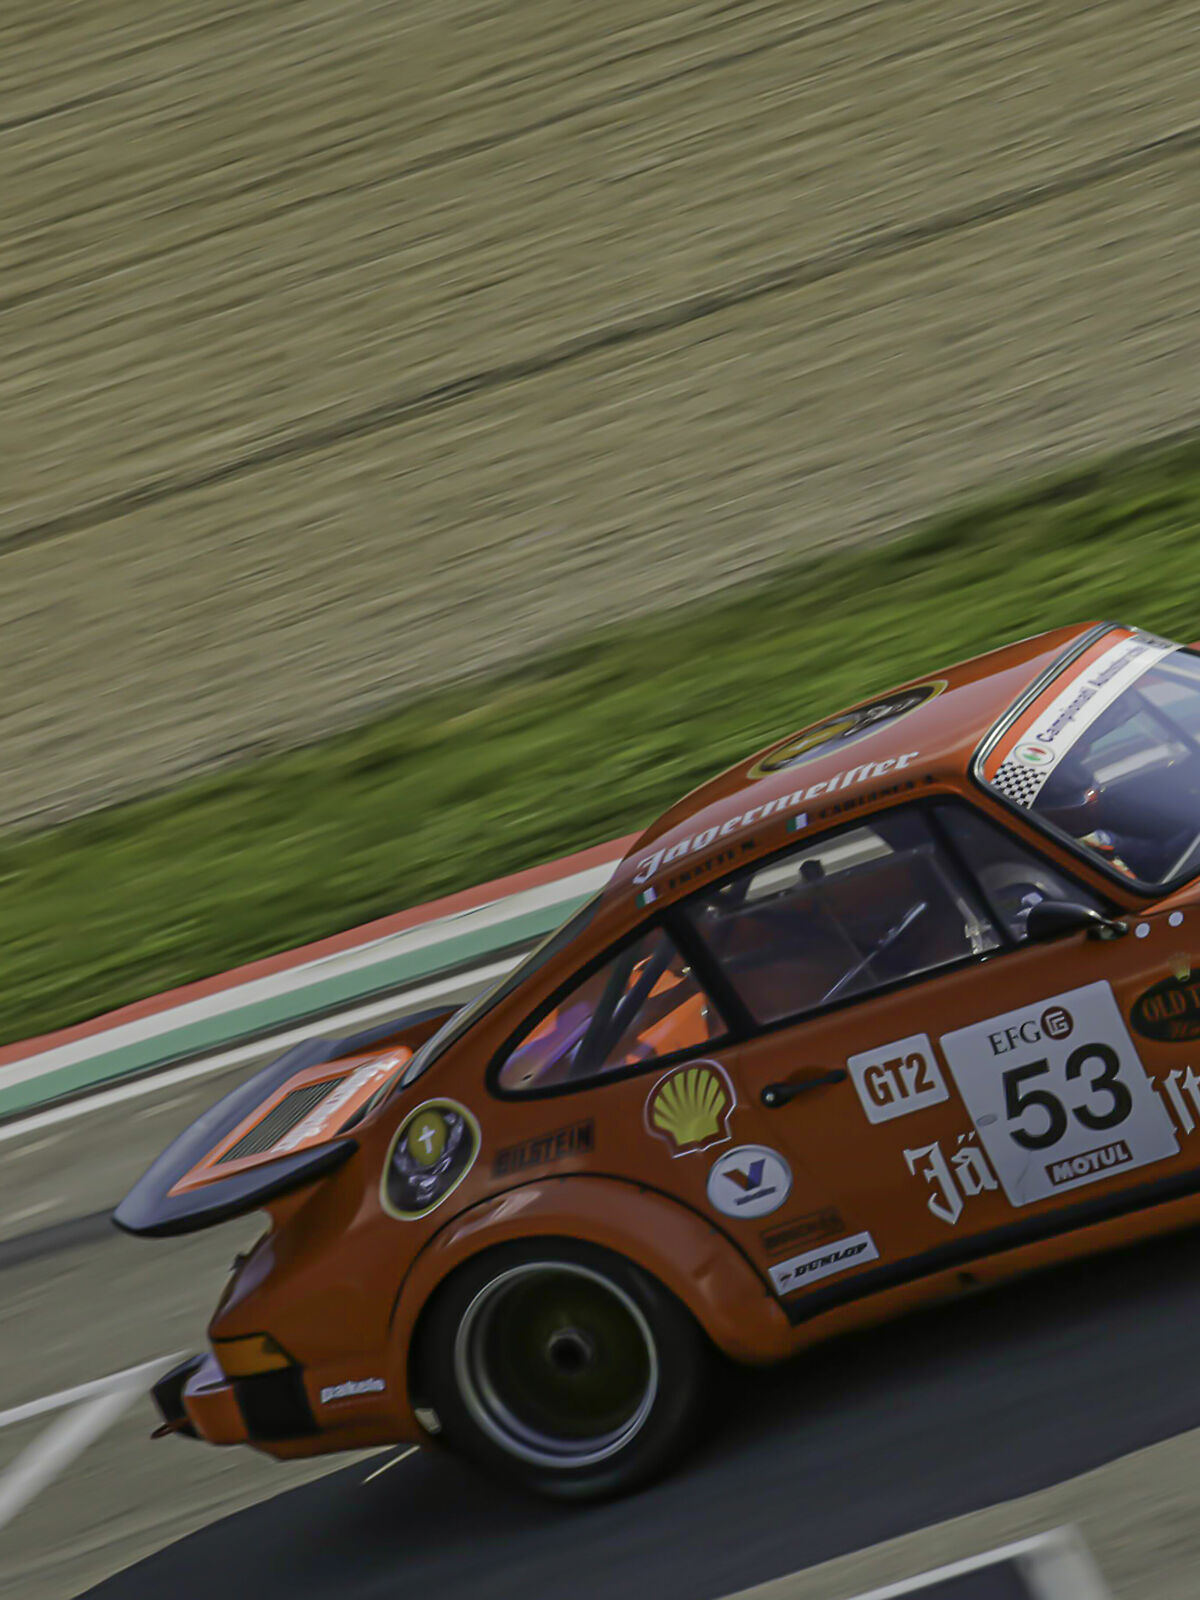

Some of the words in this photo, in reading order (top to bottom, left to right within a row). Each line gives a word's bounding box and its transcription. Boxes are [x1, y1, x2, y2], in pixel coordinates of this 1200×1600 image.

[1142, 990, 1186, 1022] OLD
[987, 1020, 1042, 1056] EFG
[863, 1052, 936, 1107] GT2
[1002, 1043, 1133, 1152] 53
[1051, 1143, 1130, 1185] MOTUL
[794, 1242, 868, 1278] DUNLOP
